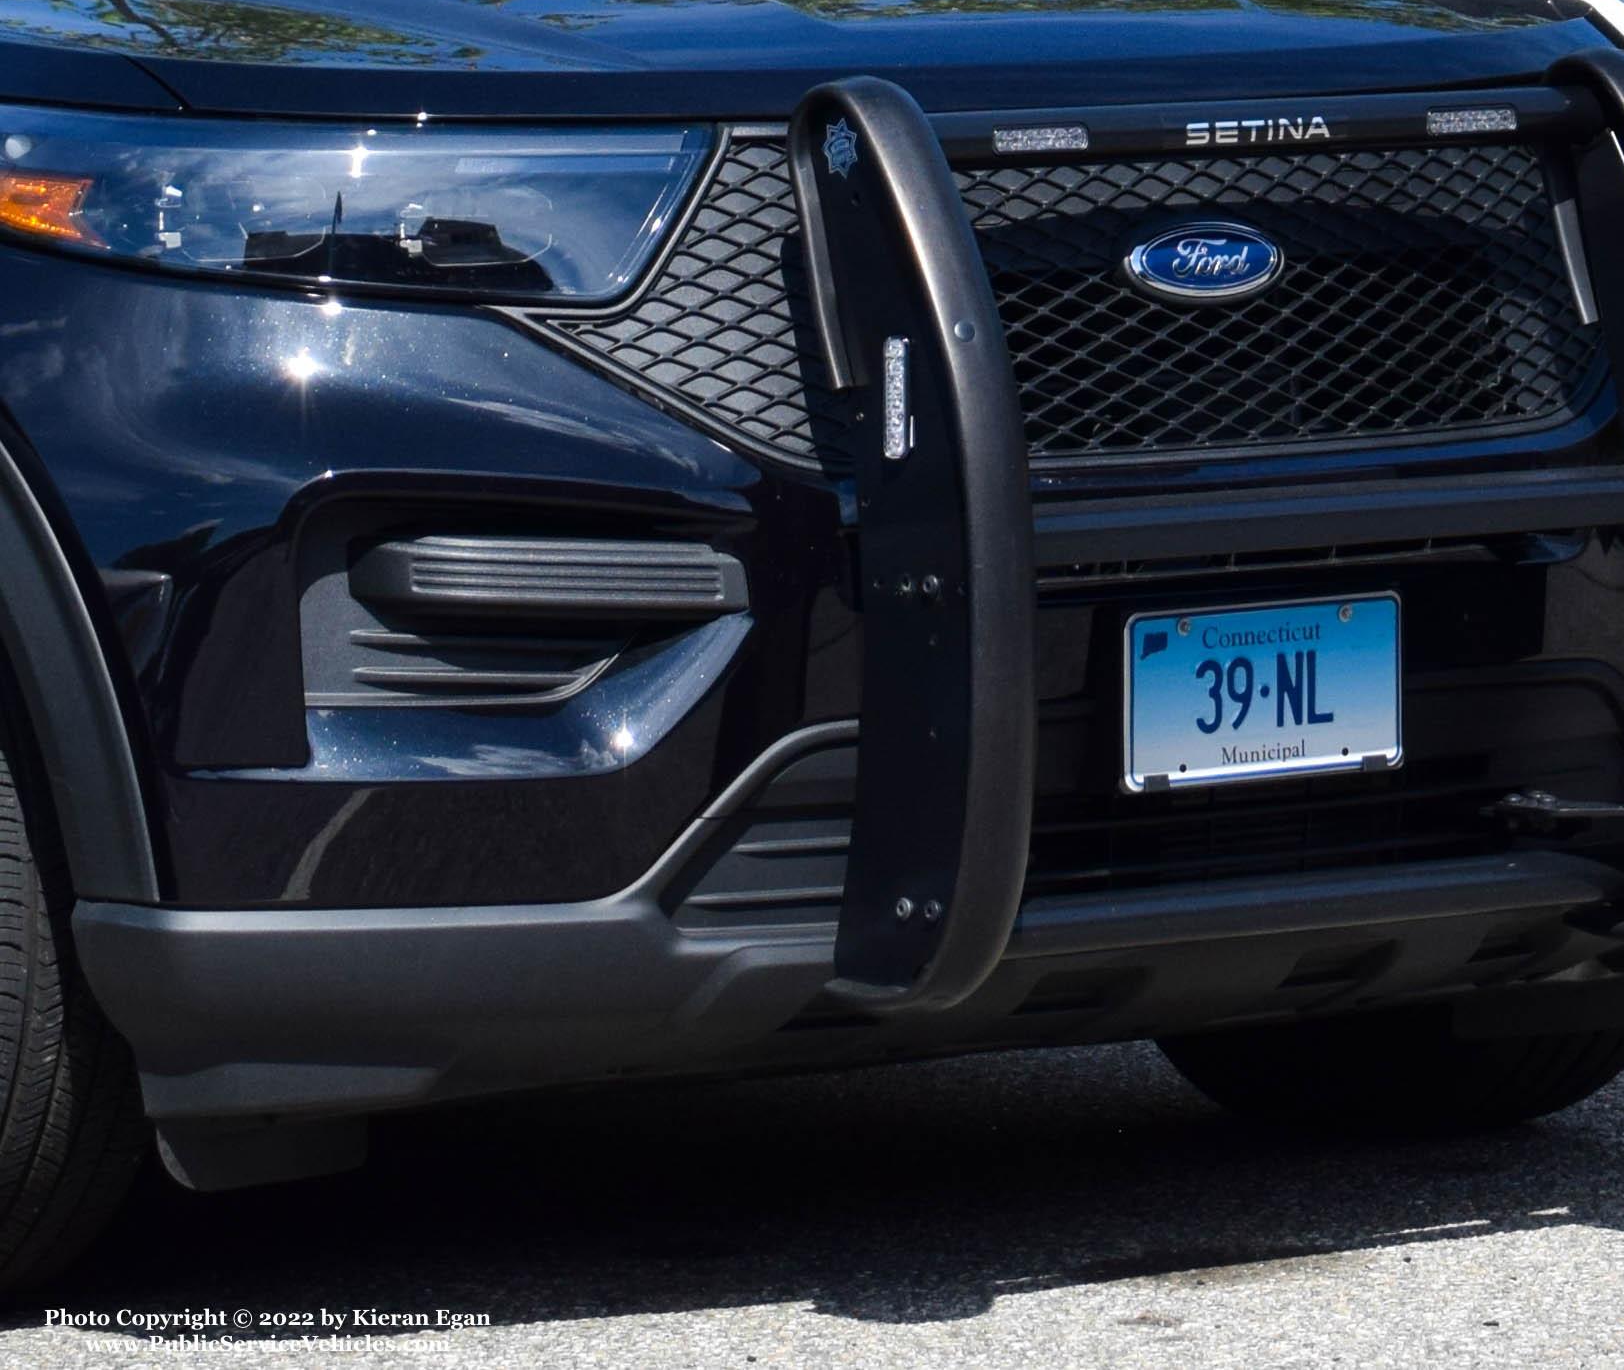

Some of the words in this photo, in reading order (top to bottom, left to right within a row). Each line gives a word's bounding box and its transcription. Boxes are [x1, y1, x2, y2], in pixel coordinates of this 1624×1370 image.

[1186, 117, 1330, 145] SETINA
[1172, 238, 1250, 278] Ford
[1202, 622, 1322, 651] Connecticut
[1221, 739, 1307, 766] Municipal
